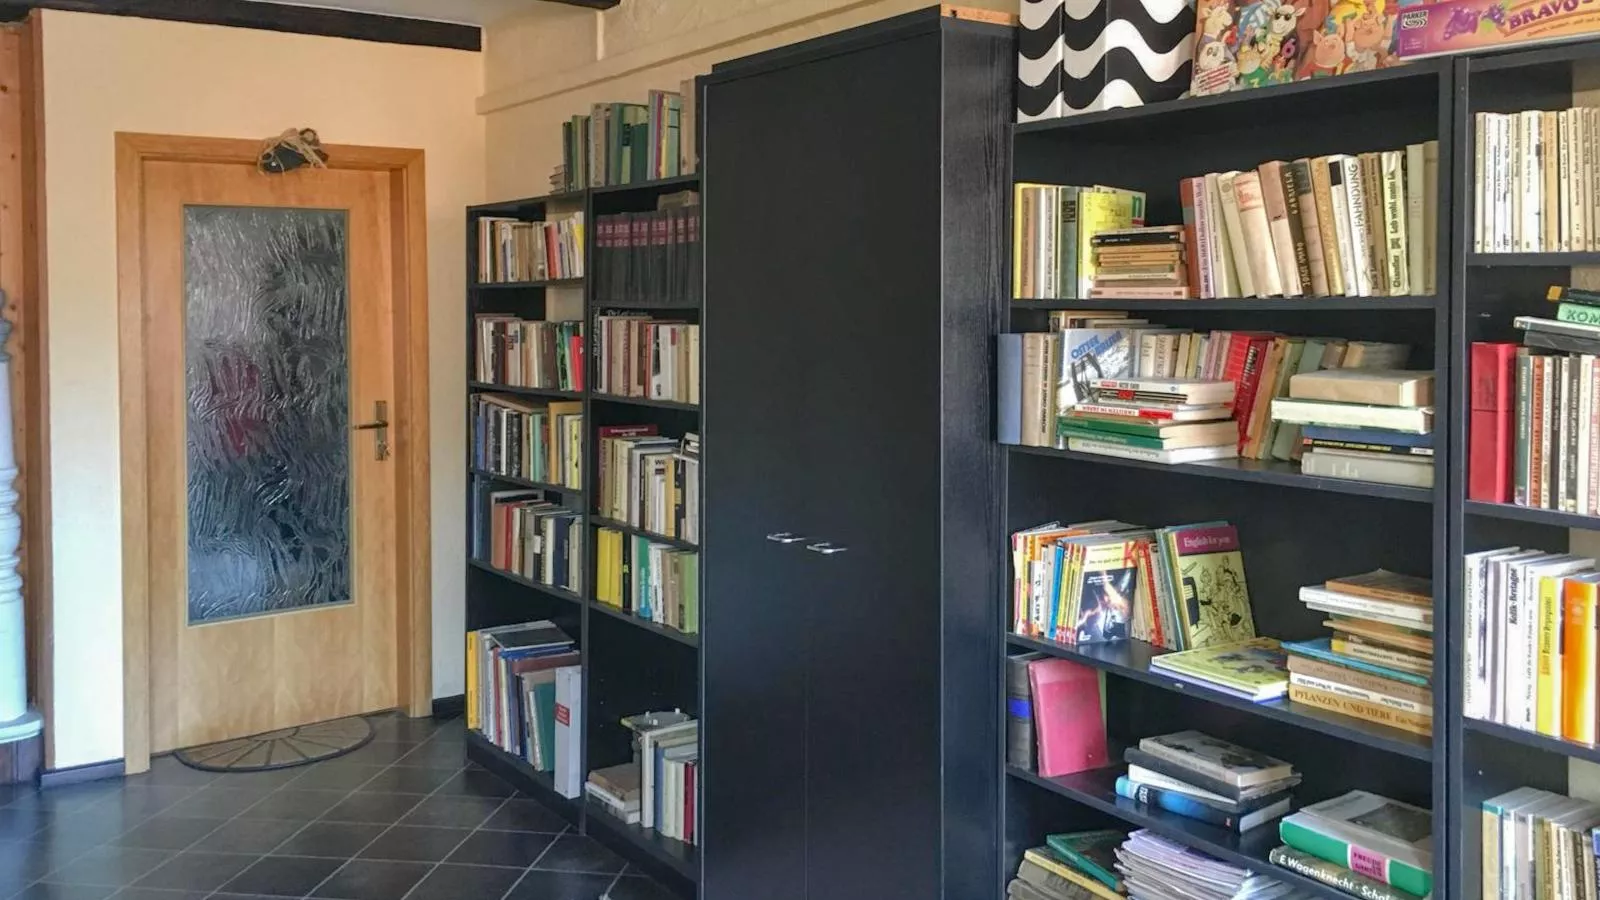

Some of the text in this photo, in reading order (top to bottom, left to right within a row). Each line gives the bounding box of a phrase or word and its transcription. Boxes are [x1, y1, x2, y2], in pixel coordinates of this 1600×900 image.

[1403, 11, 1427, 19] PARKER
[1284, 171, 1299, 215] GABRIELA
[1348, 164, 1364, 227] FAHNDUNG
[1184, 536, 1208, 548] English
[1294, 689, 1341, 707] PFLANZEN
[1342, 702, 1363, 714] UND
[1365, 707, 1391, 721] TIERE
[1287, 857, 1353, 890] Wagenknecht
